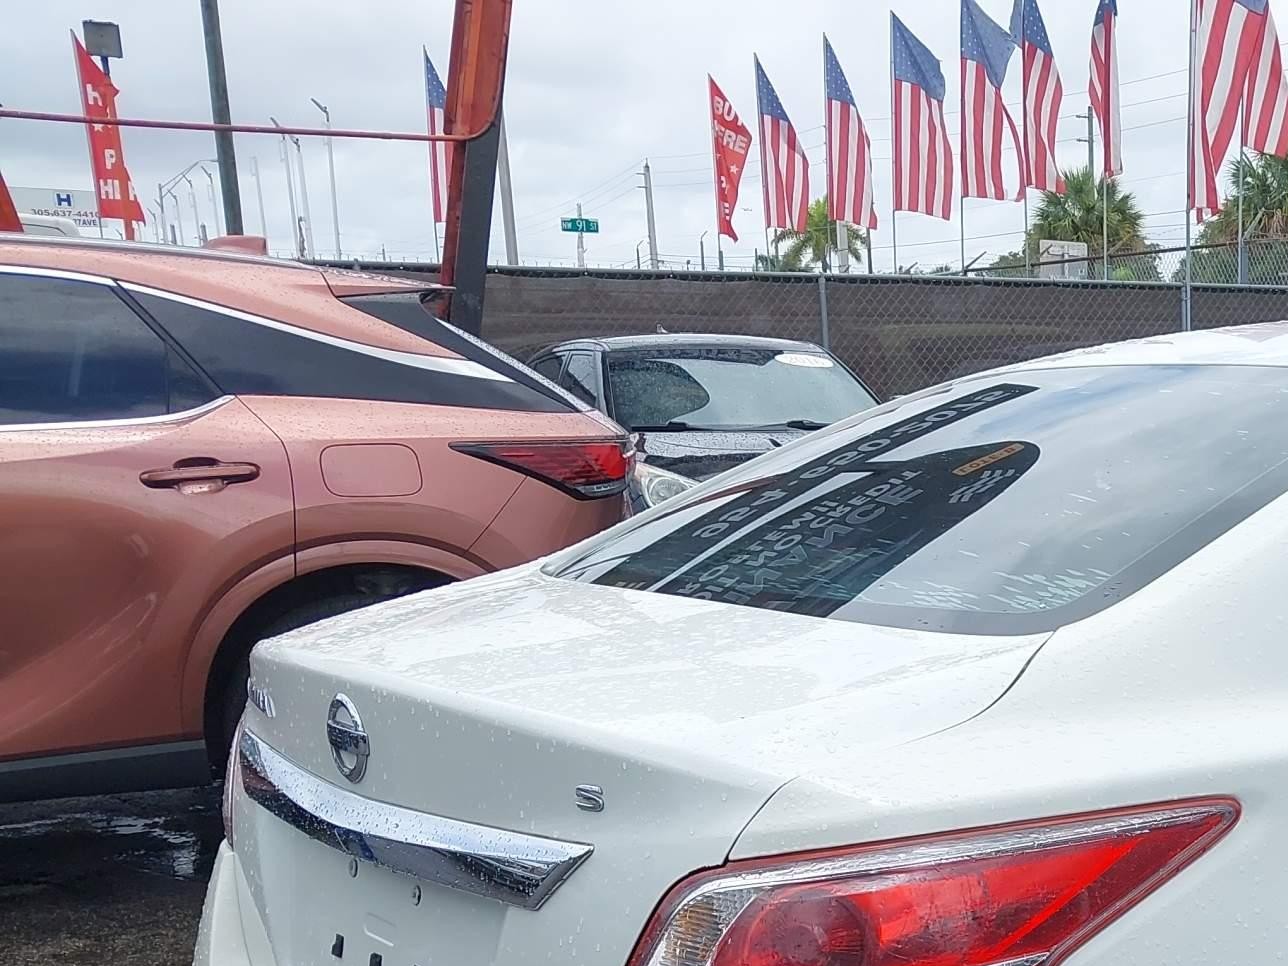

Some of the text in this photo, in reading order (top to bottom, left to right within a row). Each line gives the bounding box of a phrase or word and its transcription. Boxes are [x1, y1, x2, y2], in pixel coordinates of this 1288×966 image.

[56, 193, 72, 207] H
[82, 219, 98, 227] AVE
[575, 219, 586, 232] 91
[576, 784, 605, 813] S
